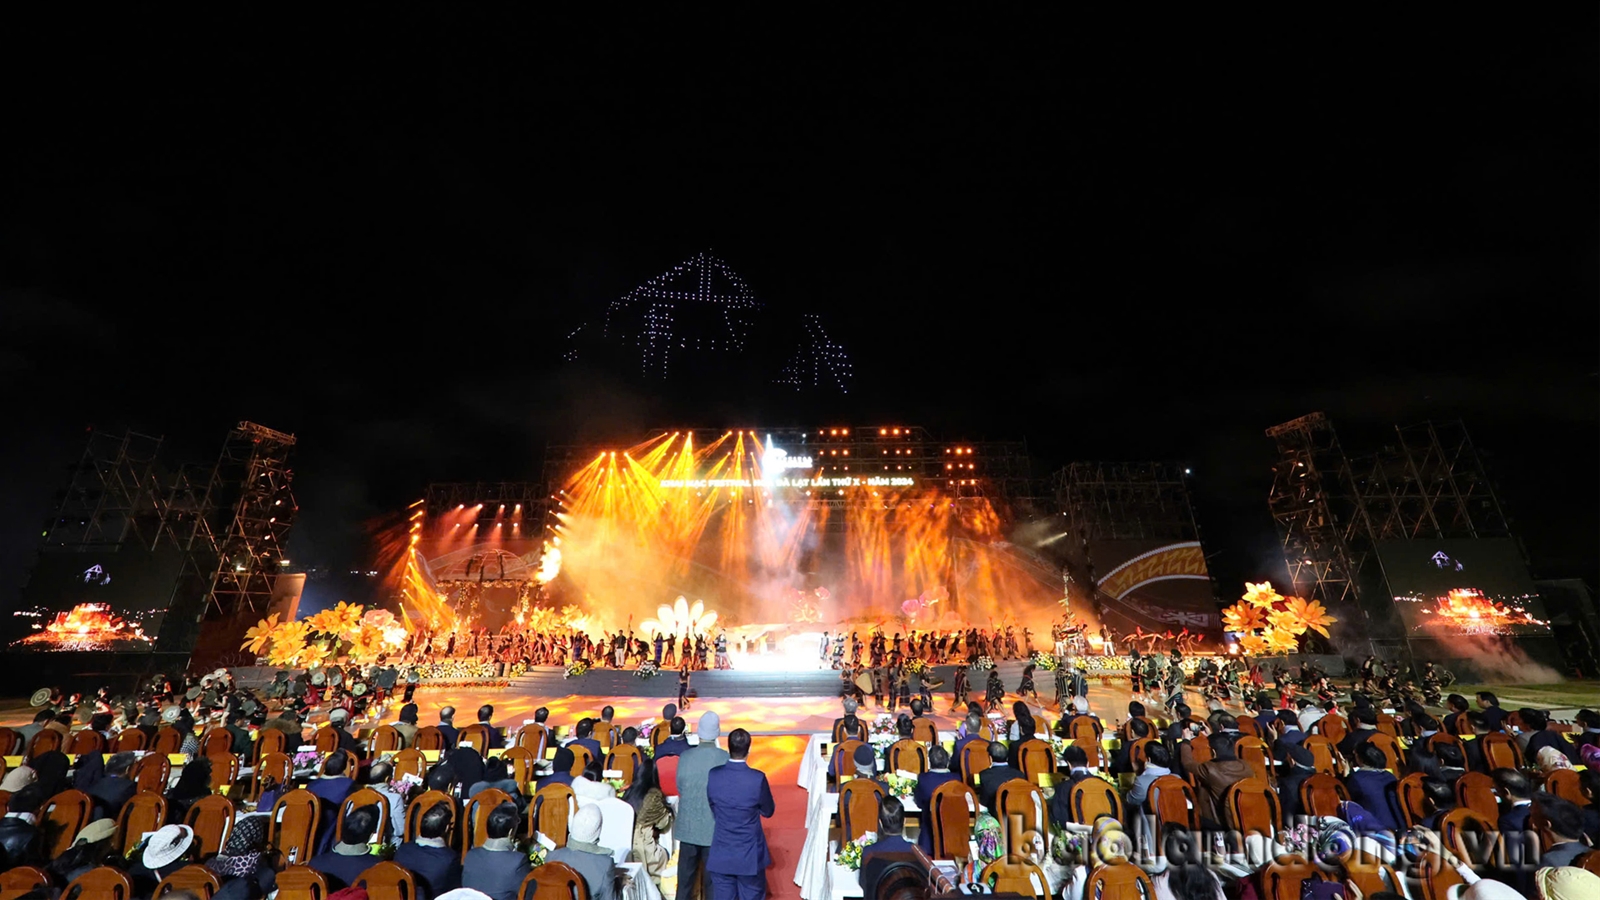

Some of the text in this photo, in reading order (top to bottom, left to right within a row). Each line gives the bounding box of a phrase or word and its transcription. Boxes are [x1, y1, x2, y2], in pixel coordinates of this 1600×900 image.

[791, 478, 810, 488] LẠT
[832, 476, 852, 486] THỨ
[853, 478, 860, 486] X
[867, 476, 890, 486] NĂM
[891, 478, 914, 486] 2024
